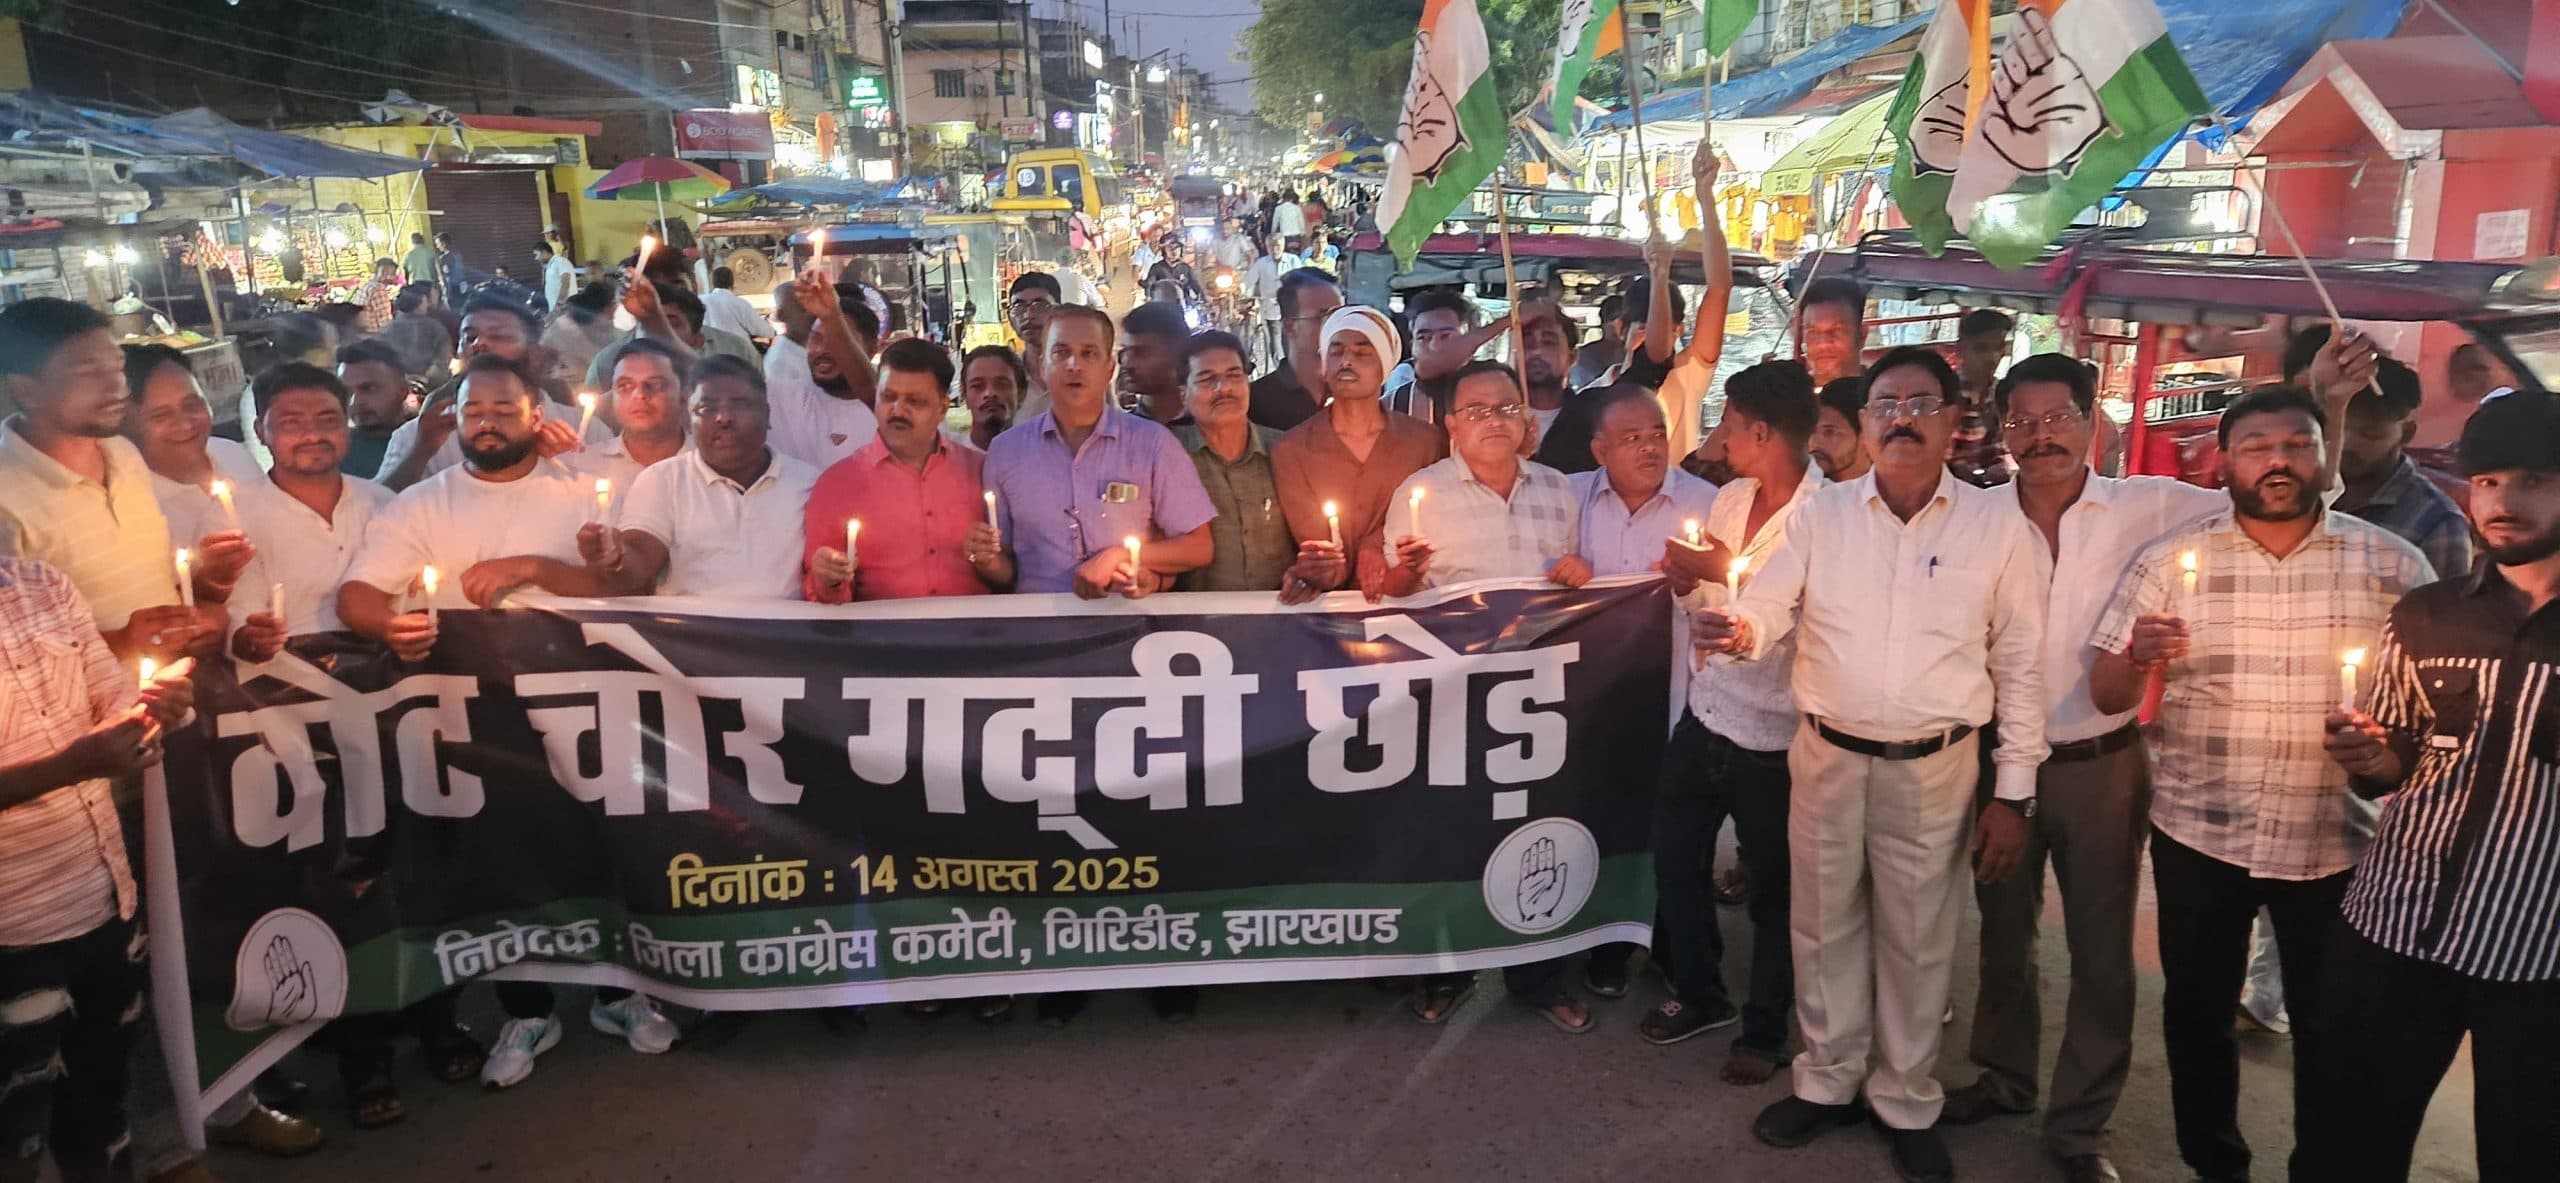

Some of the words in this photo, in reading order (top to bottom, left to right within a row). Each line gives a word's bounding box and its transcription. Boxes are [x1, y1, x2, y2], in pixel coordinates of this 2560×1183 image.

[217, 652, 486, 853] वोट
[514, 622, 806, 816] चोर
[1297, 615, 1581, 821] छोड़
[667, 853, 808, 908] दिनांक
[824, 869, 834, 892] :
[850, 855, 898, 895] 14
[912, 856, 1038, 894] अगस्त
[1052, 856, 1160, 892] 2025
[434, 919, 601, 985] निवेदक
[629, 922, 724, 977] जिला
[737, 919, 877, 977] कांग्रेस
[890, 907, 1031, 966] कमेटी,
[1043, 904, 1213, 957] गिरिडीह,
[1222, 908, 1402, 954] झारखण्ड
